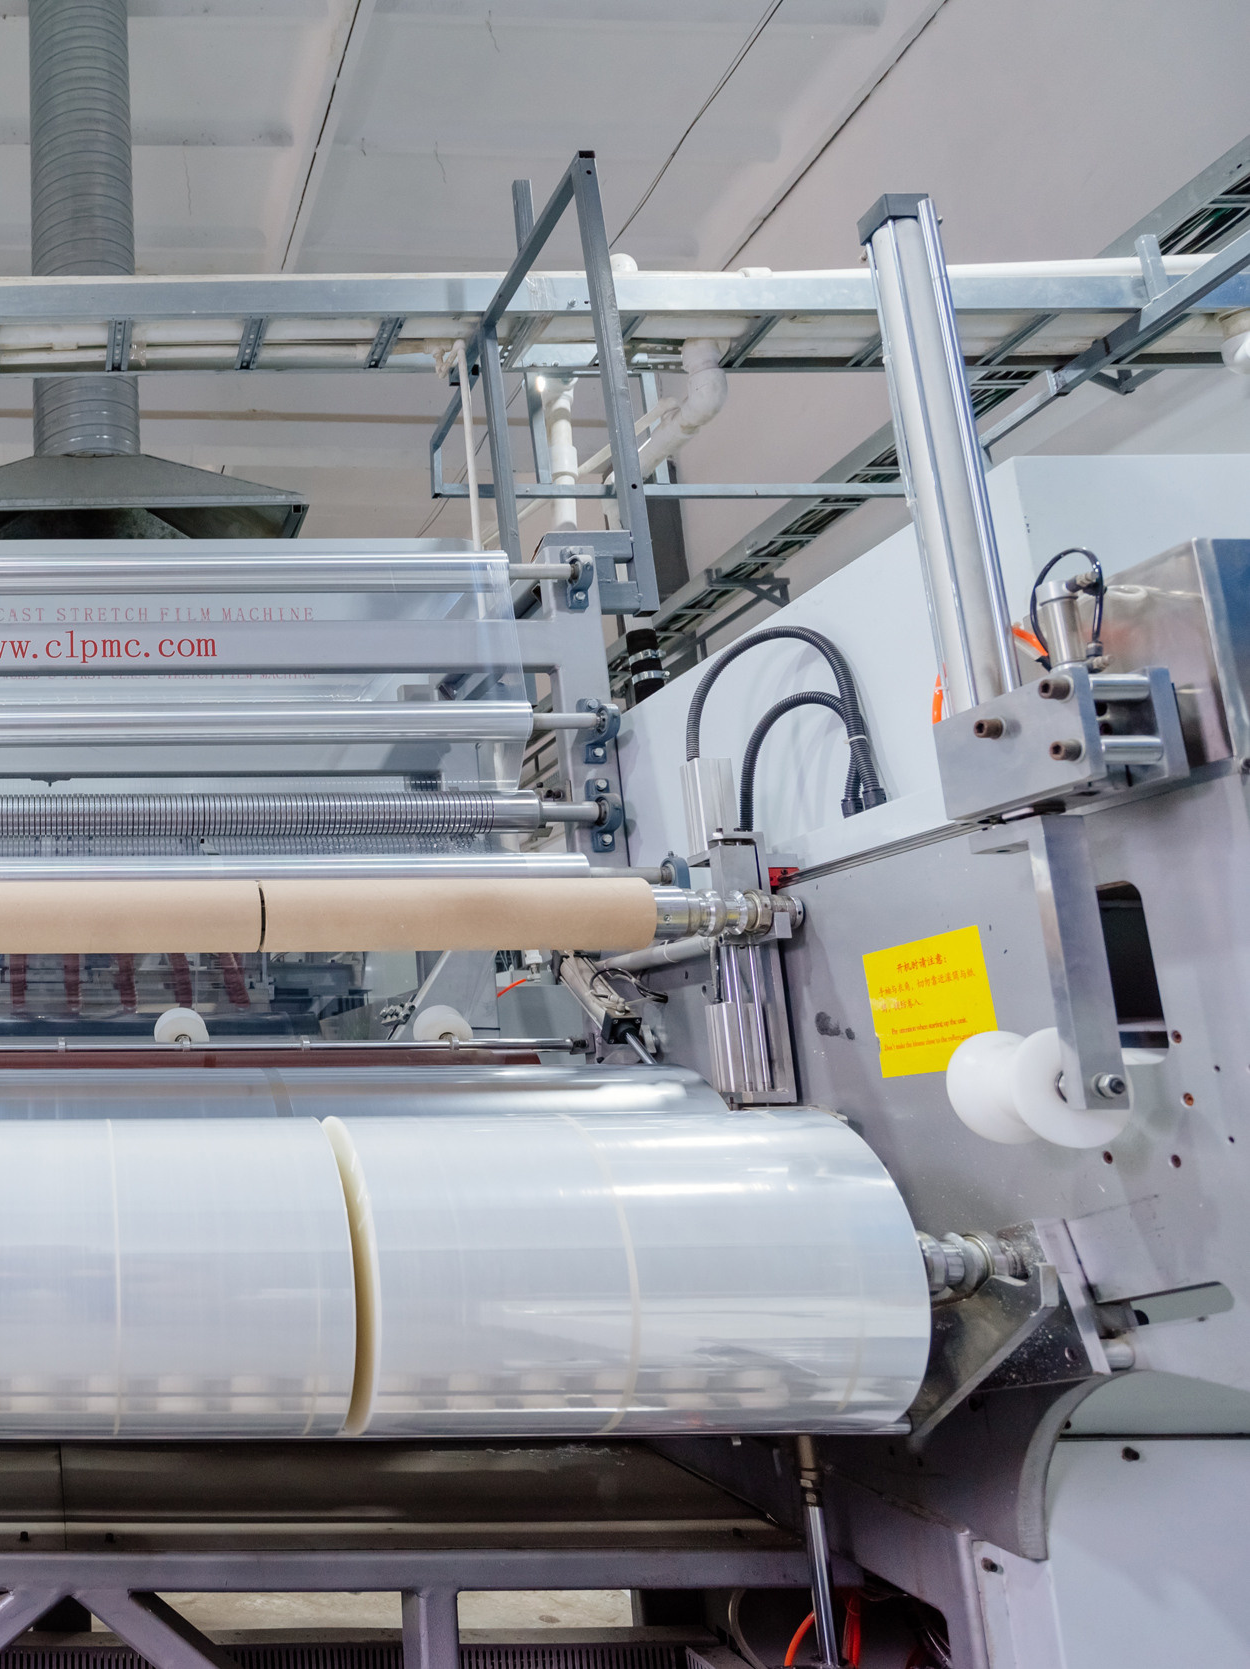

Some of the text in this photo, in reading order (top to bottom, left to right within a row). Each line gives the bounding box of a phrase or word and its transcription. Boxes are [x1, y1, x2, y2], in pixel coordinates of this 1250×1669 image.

[56, 607, 148, 622] STRETCH
[160, 607, 210, 622] FILM
[222, 607, 314, 622] MACHINE
